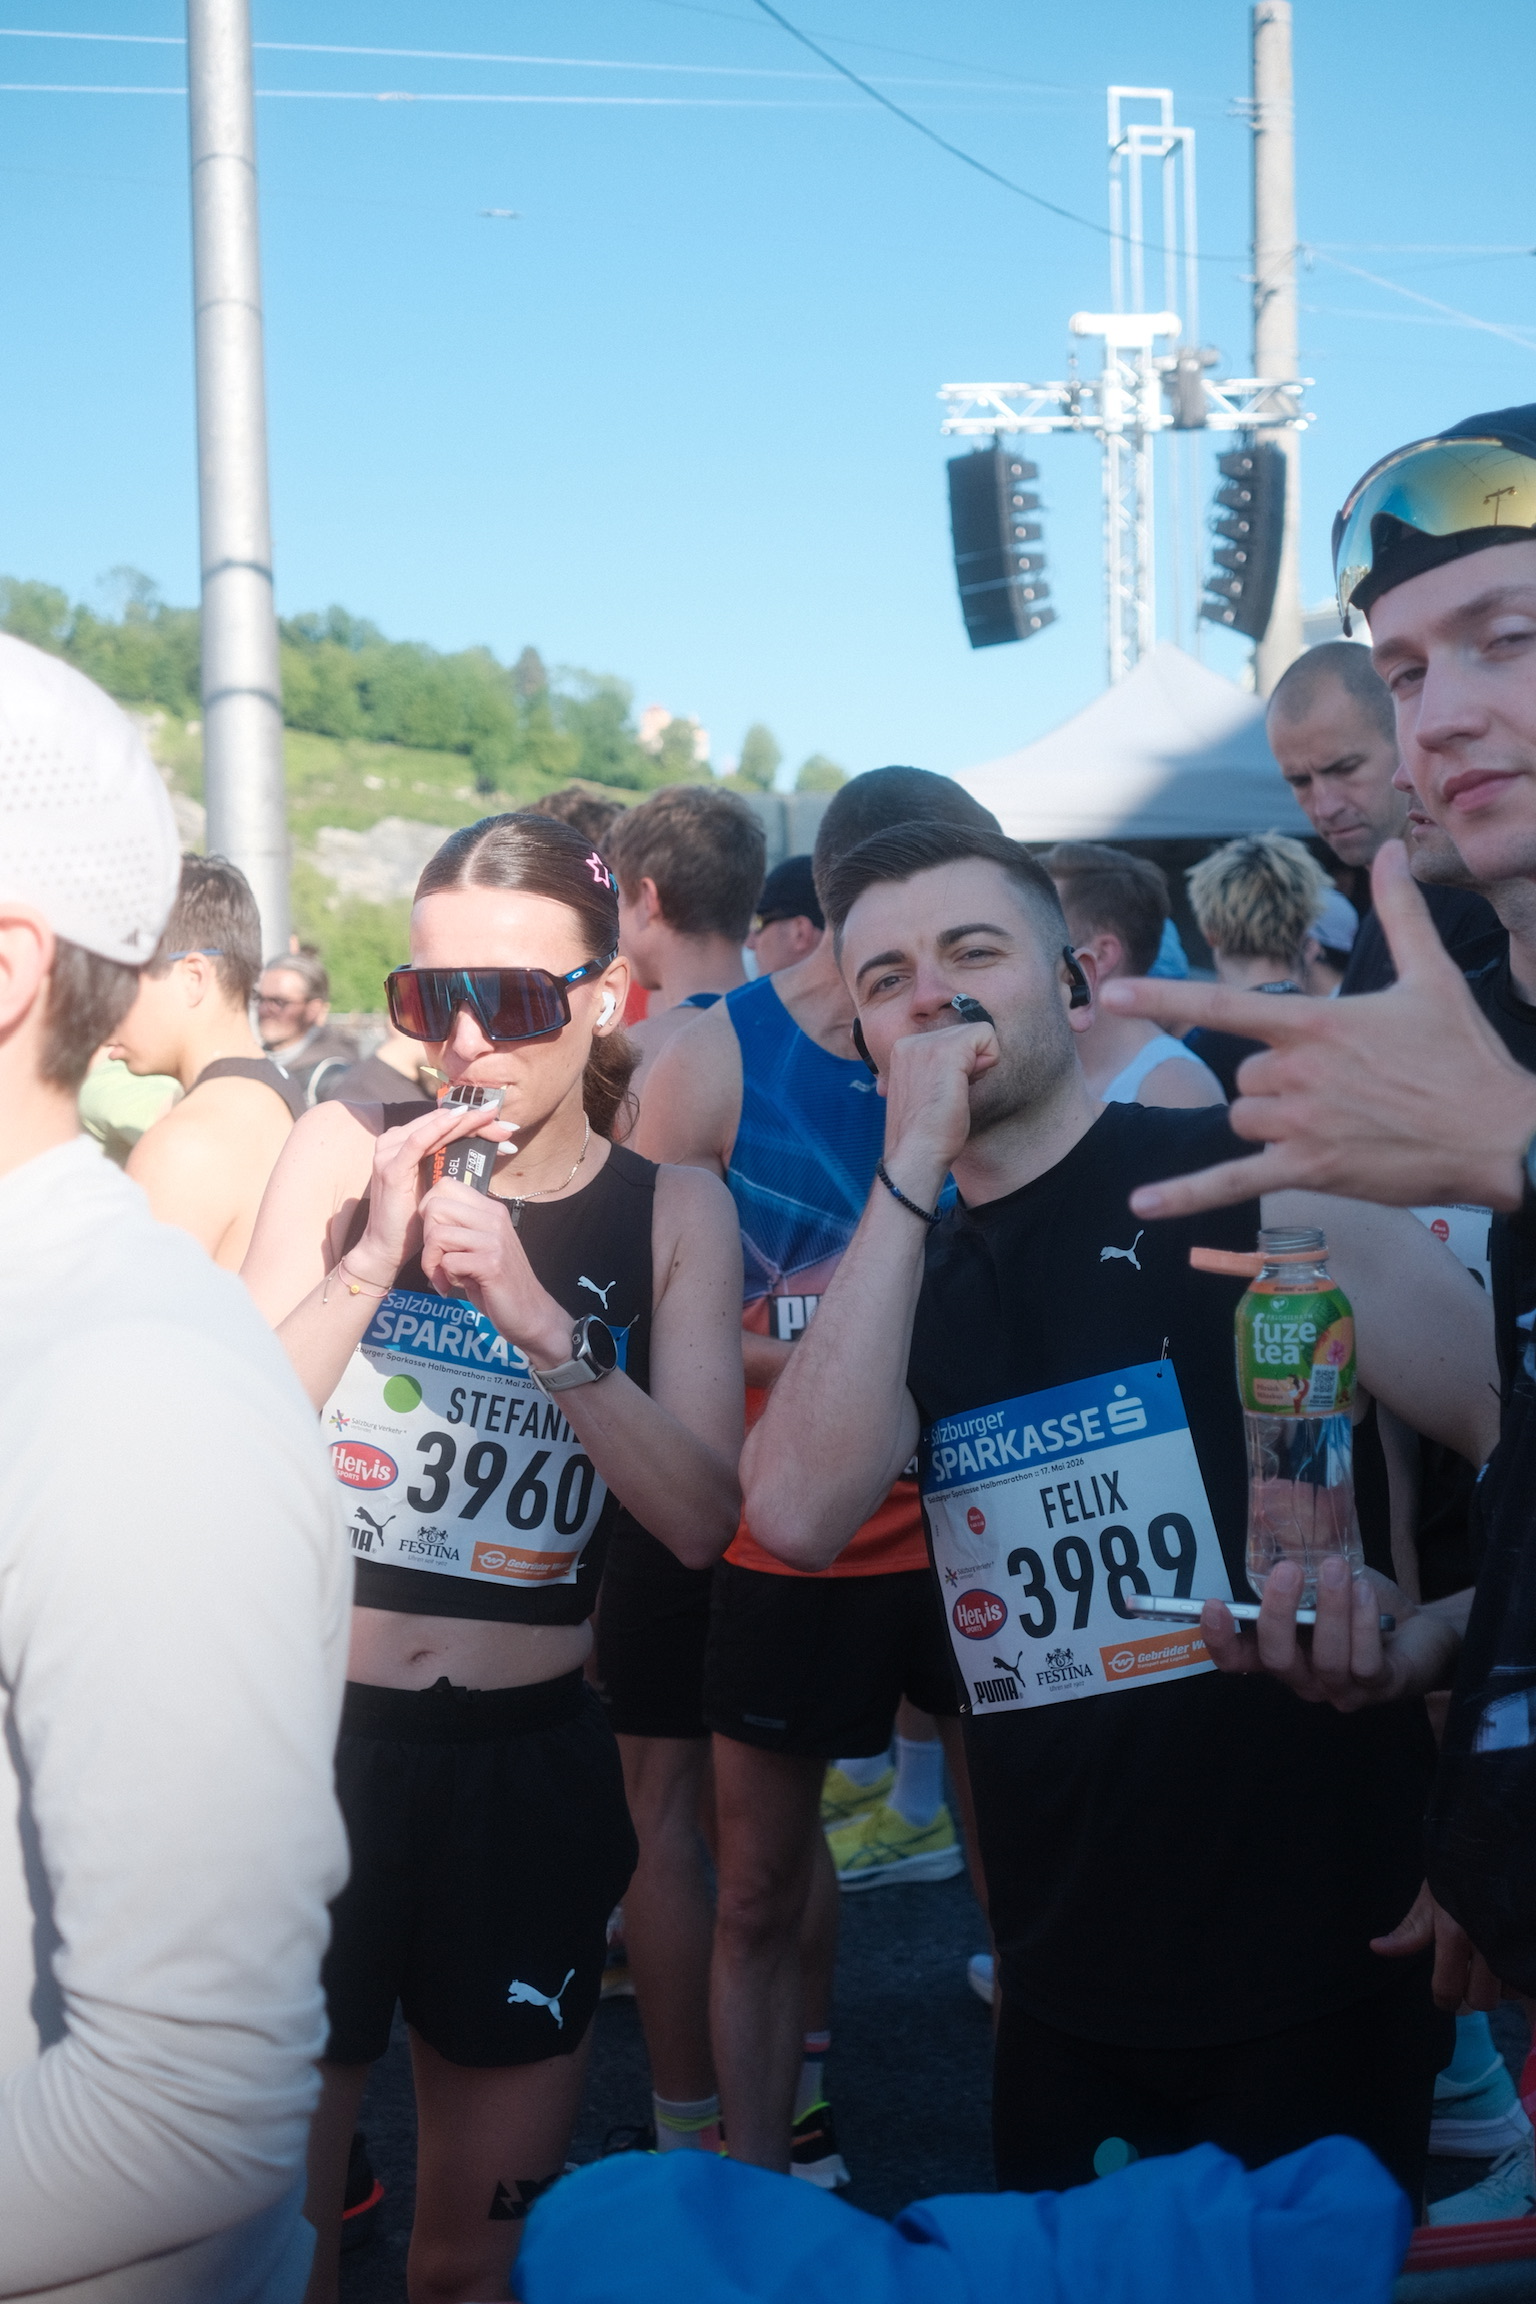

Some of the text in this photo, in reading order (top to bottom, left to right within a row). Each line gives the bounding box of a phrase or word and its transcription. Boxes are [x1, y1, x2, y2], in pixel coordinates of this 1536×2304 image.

[448, 1157, 460, 1175] GEL
[382, 1292, 484, 1327] Salzburger
[1252, 1313, 1317, 1343] fuze
[1253, 1341, 1301, 1365] tea
[386, 1352, 427, 1369] Sparkasse
[428, 1362, 486, 1381] Halbmarathon
[494, 1376, 504, 1385] 17.
[505, 1379, 520, 1388] Mai
[351, 1417, 377, 1430] Salzburg
[446, 1387, 581, 1444] STEFANI
[930, 1410, 1005, 1447] Salzburger
[931, 1407, 1106, 1483] SPARKASSE
[331, 1446, 391, 1481] Hervis
[336, 1470, 360, 1481] SPORTS
[951, 1485, 980, 1498] Sparkasse
[980, 1472, 1034, 1490] Halbmarathon
[1041, 1467, 1050, 1476] 17.
[1051, 1463, 1065, 1473] Mai
[1066, 1457, 1085, 1469] 2026
[406, 1431, 596, 1536] 3960
[1039, 1470, 1129, 1529] FELIX
[398, 1538, 460, 1561] FESTINA
[1007, 1512, 1198, 1639] 3989
[956, 1601, 1003, 1628] Hervis
[1137, 1644, 1190, 1663] Gebrüder
[973, 1676, 1019, 1704] PUMA
[1036, 1663, 1094, 1686] FESTINA
